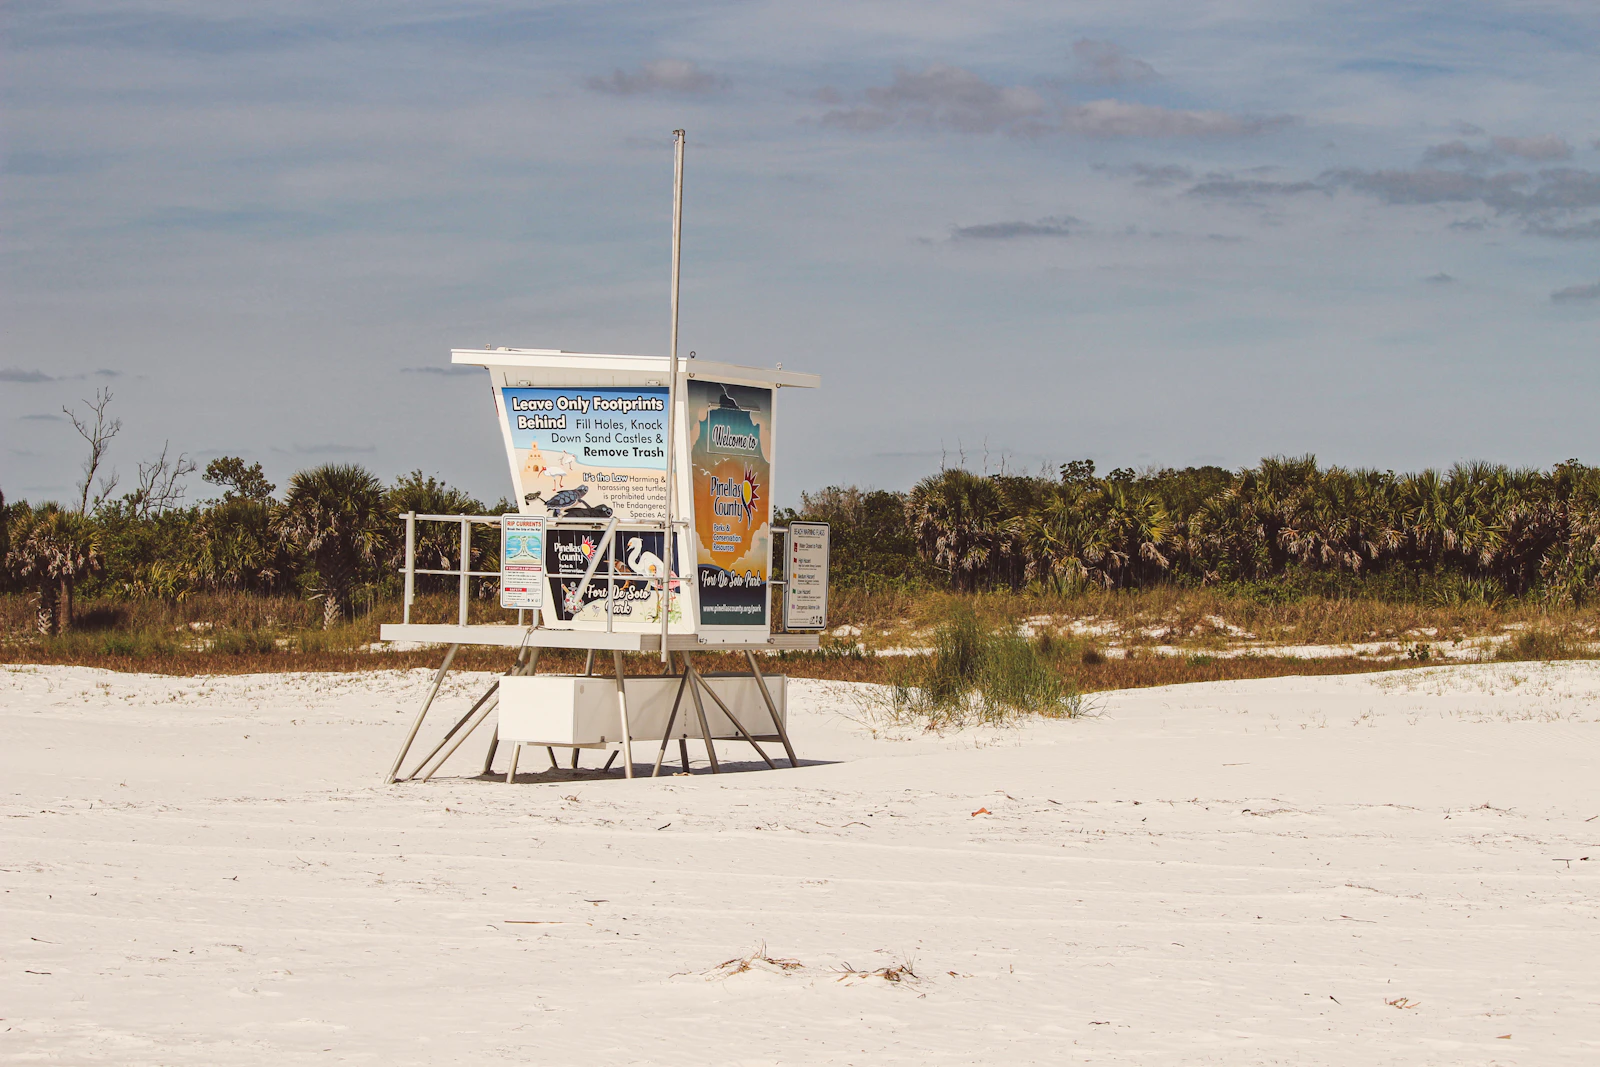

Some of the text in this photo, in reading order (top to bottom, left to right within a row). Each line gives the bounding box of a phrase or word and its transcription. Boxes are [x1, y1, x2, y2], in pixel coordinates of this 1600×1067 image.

[512, 395, 664, 414] Leave Only Footprints
[518, 414, 663, 431] Behind Fill Holes, Knock
[551, 433, 664, 444] Down Sand Castles &
[712, 424, 759, 451] Welcome to
[584, 447, 664, 458] Remove Trash
[583, 472, 596, 483] It's
[597, 472, 610, 482] the
[612, 473, 628, 482] Law
[629, 476, 659, 484] Harming
[598, 484, 630, 492] harassing
[710, 476, 742, 497] Pinellas
[610, 493, 645, 501] prohibited
[713, 497, 743, 522] County
[713, 523, 730, 532] Parks &
[713, 534, 742, 543] Conservation
[553, 542, 581, 552] Pinellas
[713, 542, 735, 552] Resources
[558, 552, 584, 564] County
[701, 569, 761, 588] Fort De Soto Park
[585, 584, 608, 599] Fort
[626, 585, 651, 600] Soto
[703, 604, 762, 614] www.pinellascounty.org/park
